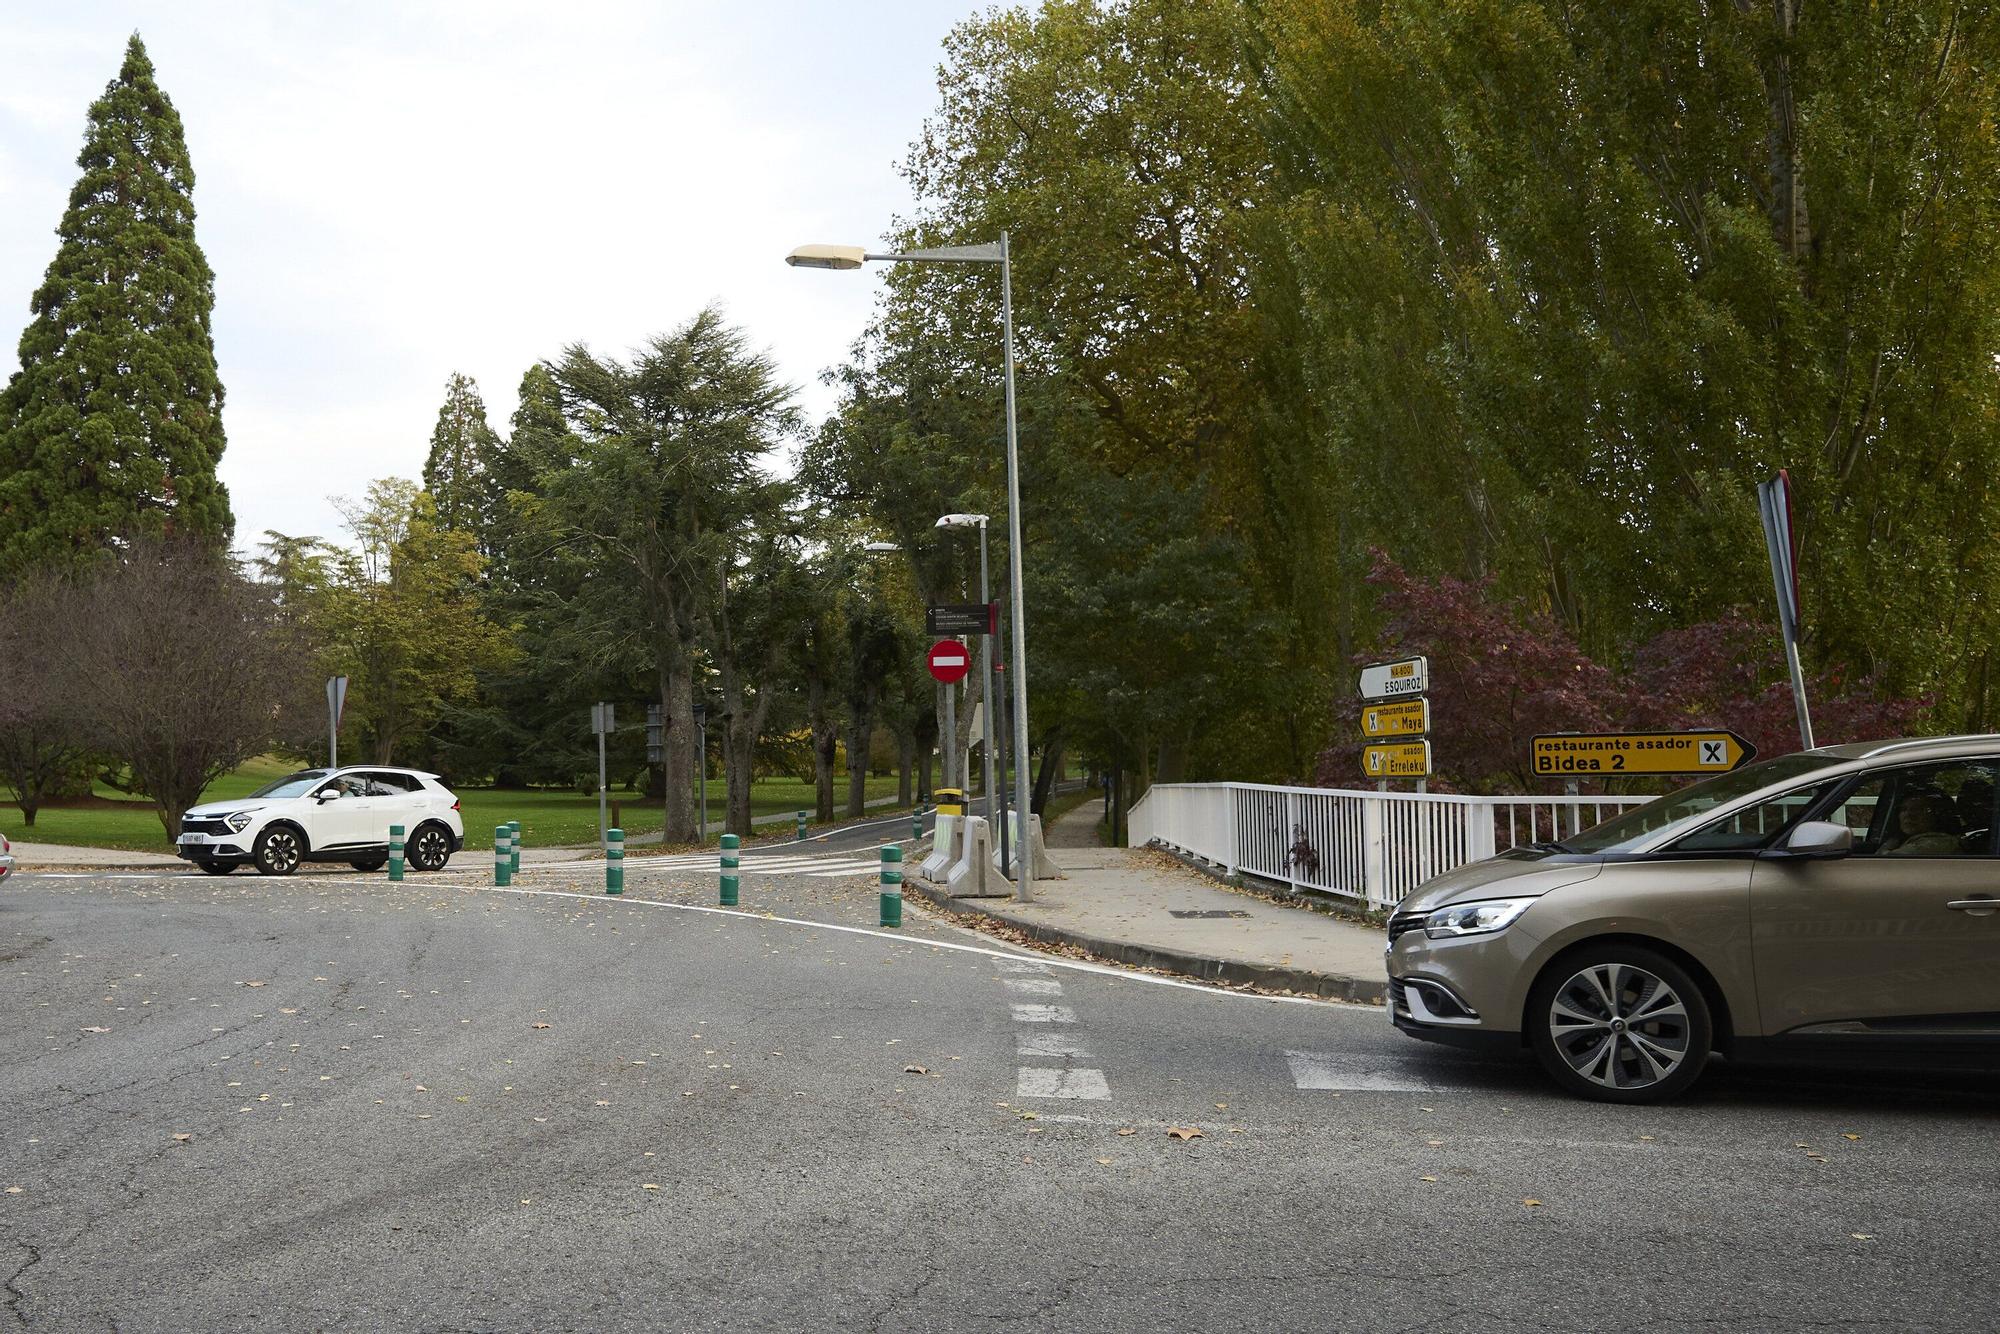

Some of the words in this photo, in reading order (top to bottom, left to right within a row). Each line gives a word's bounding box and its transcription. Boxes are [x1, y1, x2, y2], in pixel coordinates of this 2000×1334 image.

[1385, 677, 1421, 693] ESQUIROZ
[1377, 706, 1403, 716] restaurante
[1405, 703, 1421, 713] asador
[1402, 717, 1422, 731] Maya
[1404, 746, 1423, 755] asador
[1538, 739, 1631, 751] restaurante
[1636, 738, 1692, 749] asador
[1391, 760, 1424, 773] Erreleku
[1539, 755, 1601, 771] Bidea
[1611, 754, 1625, 770] 2
